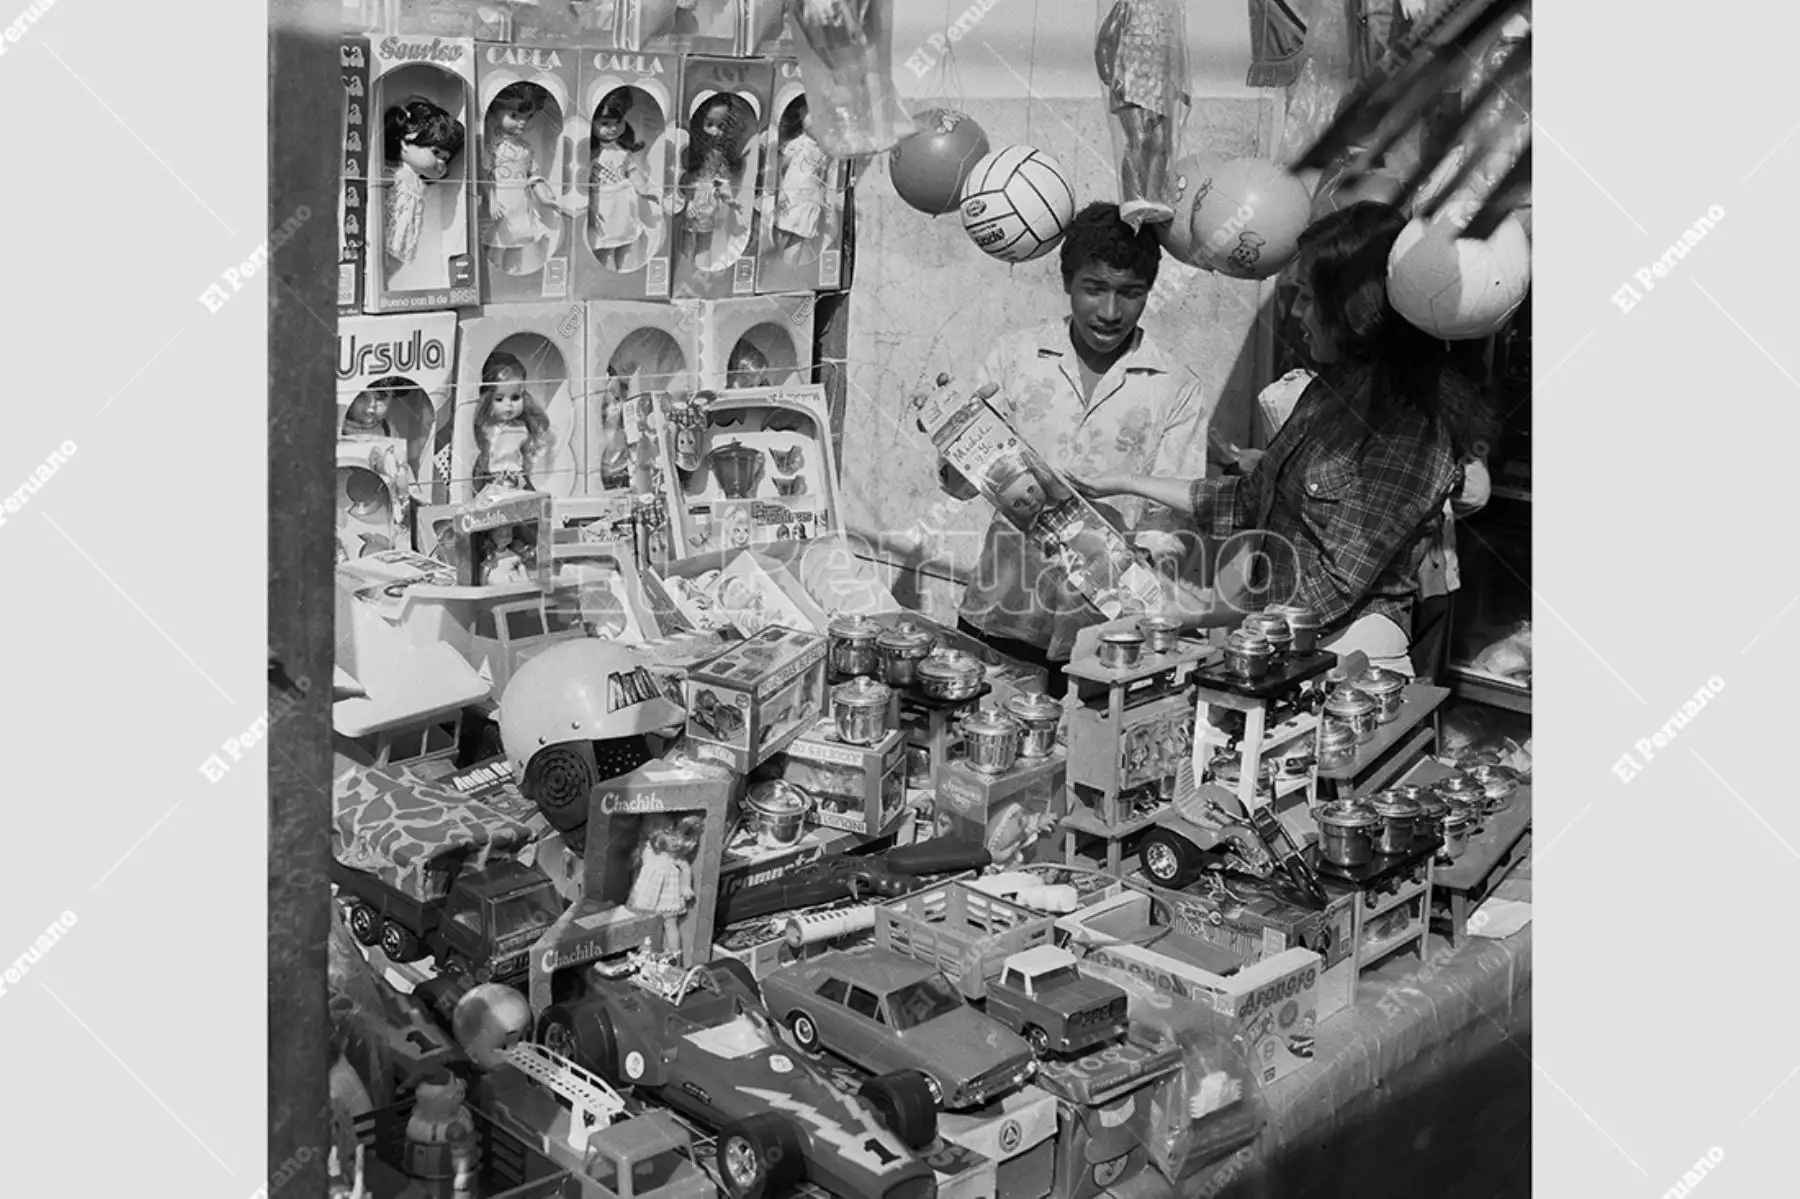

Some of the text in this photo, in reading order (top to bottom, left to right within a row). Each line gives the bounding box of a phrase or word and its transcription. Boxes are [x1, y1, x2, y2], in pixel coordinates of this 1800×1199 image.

[486, 46, 563, 71] CARLA
[593, 52, 665, 77] CARLA
[336, 329, 446, 381] Ursula
[864, 1137, 903, 1166] 1
